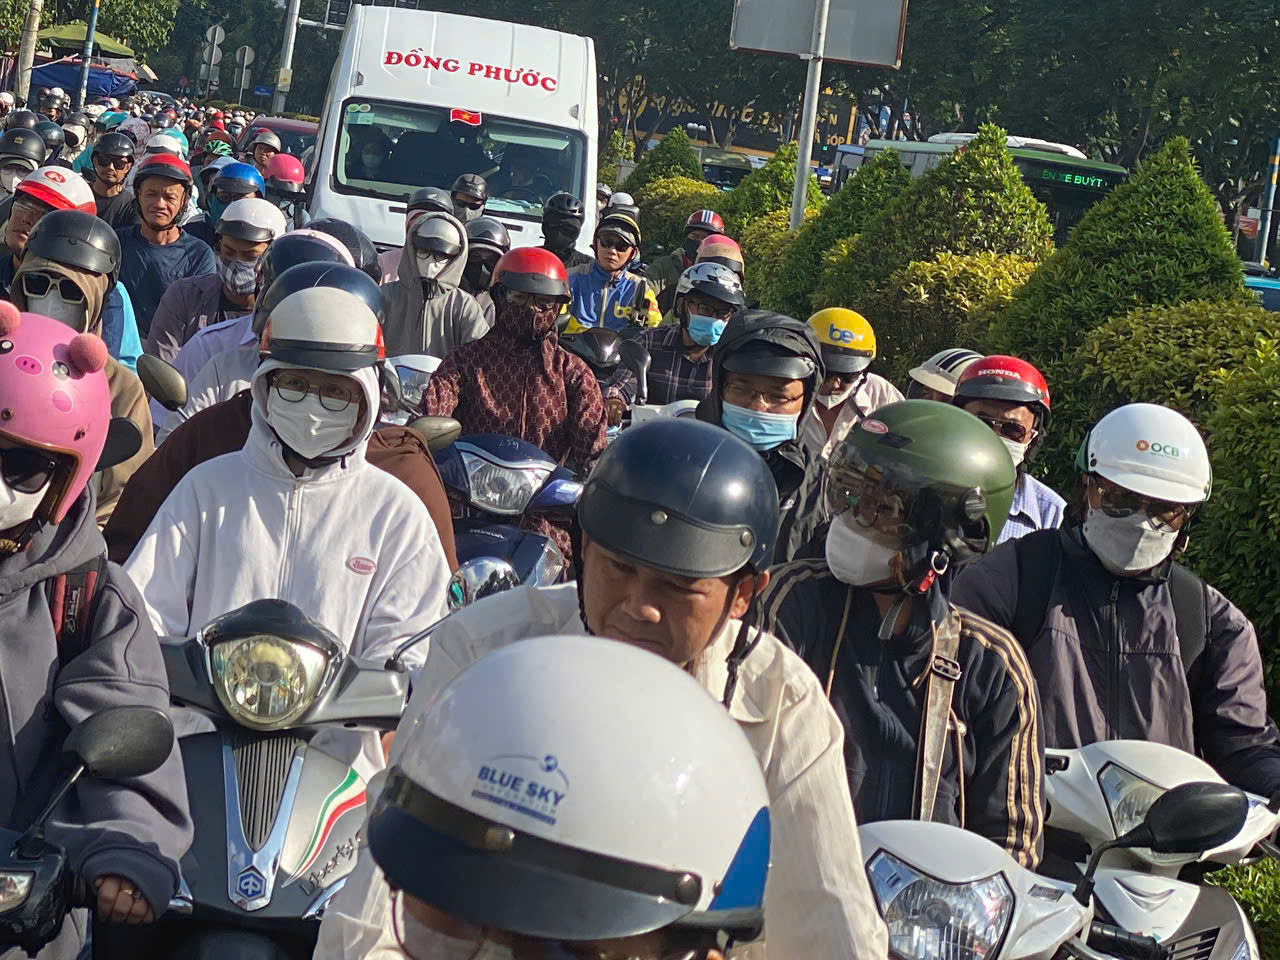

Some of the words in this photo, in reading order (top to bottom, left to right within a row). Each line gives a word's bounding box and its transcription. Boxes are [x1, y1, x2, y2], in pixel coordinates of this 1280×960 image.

[383, 47, 461, 73] ĐỒNG
[467, 61, 558, 92] PHƯỚC
[1073, 175, 1103, 188] BUÝT
[828, 323, 854, 344] be
[977, 369, 1021, 380] HONDA
[1150, 442, 1180, 457] OCB
[478, 766, 524, 792] BLUE
[526, 781, 565, 807] SKY
